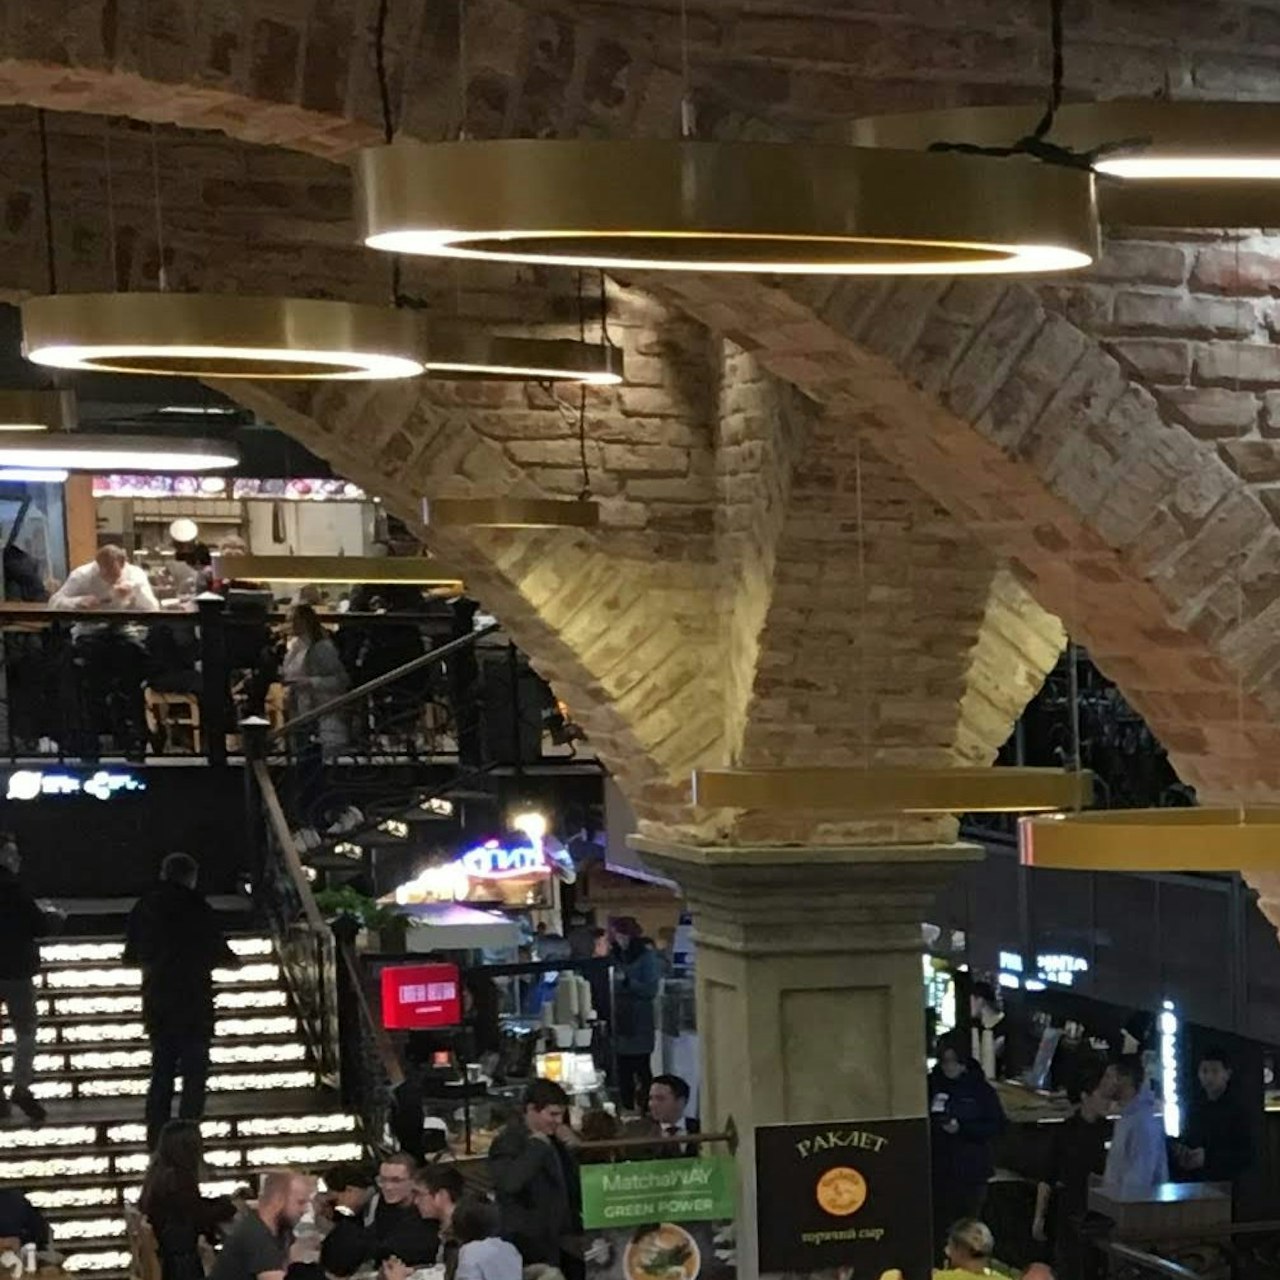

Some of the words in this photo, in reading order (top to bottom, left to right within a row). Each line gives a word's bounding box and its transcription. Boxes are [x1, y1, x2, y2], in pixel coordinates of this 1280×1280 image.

[796, 1130, 888, 1158] РАКЛЕТ
[603, 1203, 654, 1218] GREEN
[658, 1198, 713, 1214] POWER
